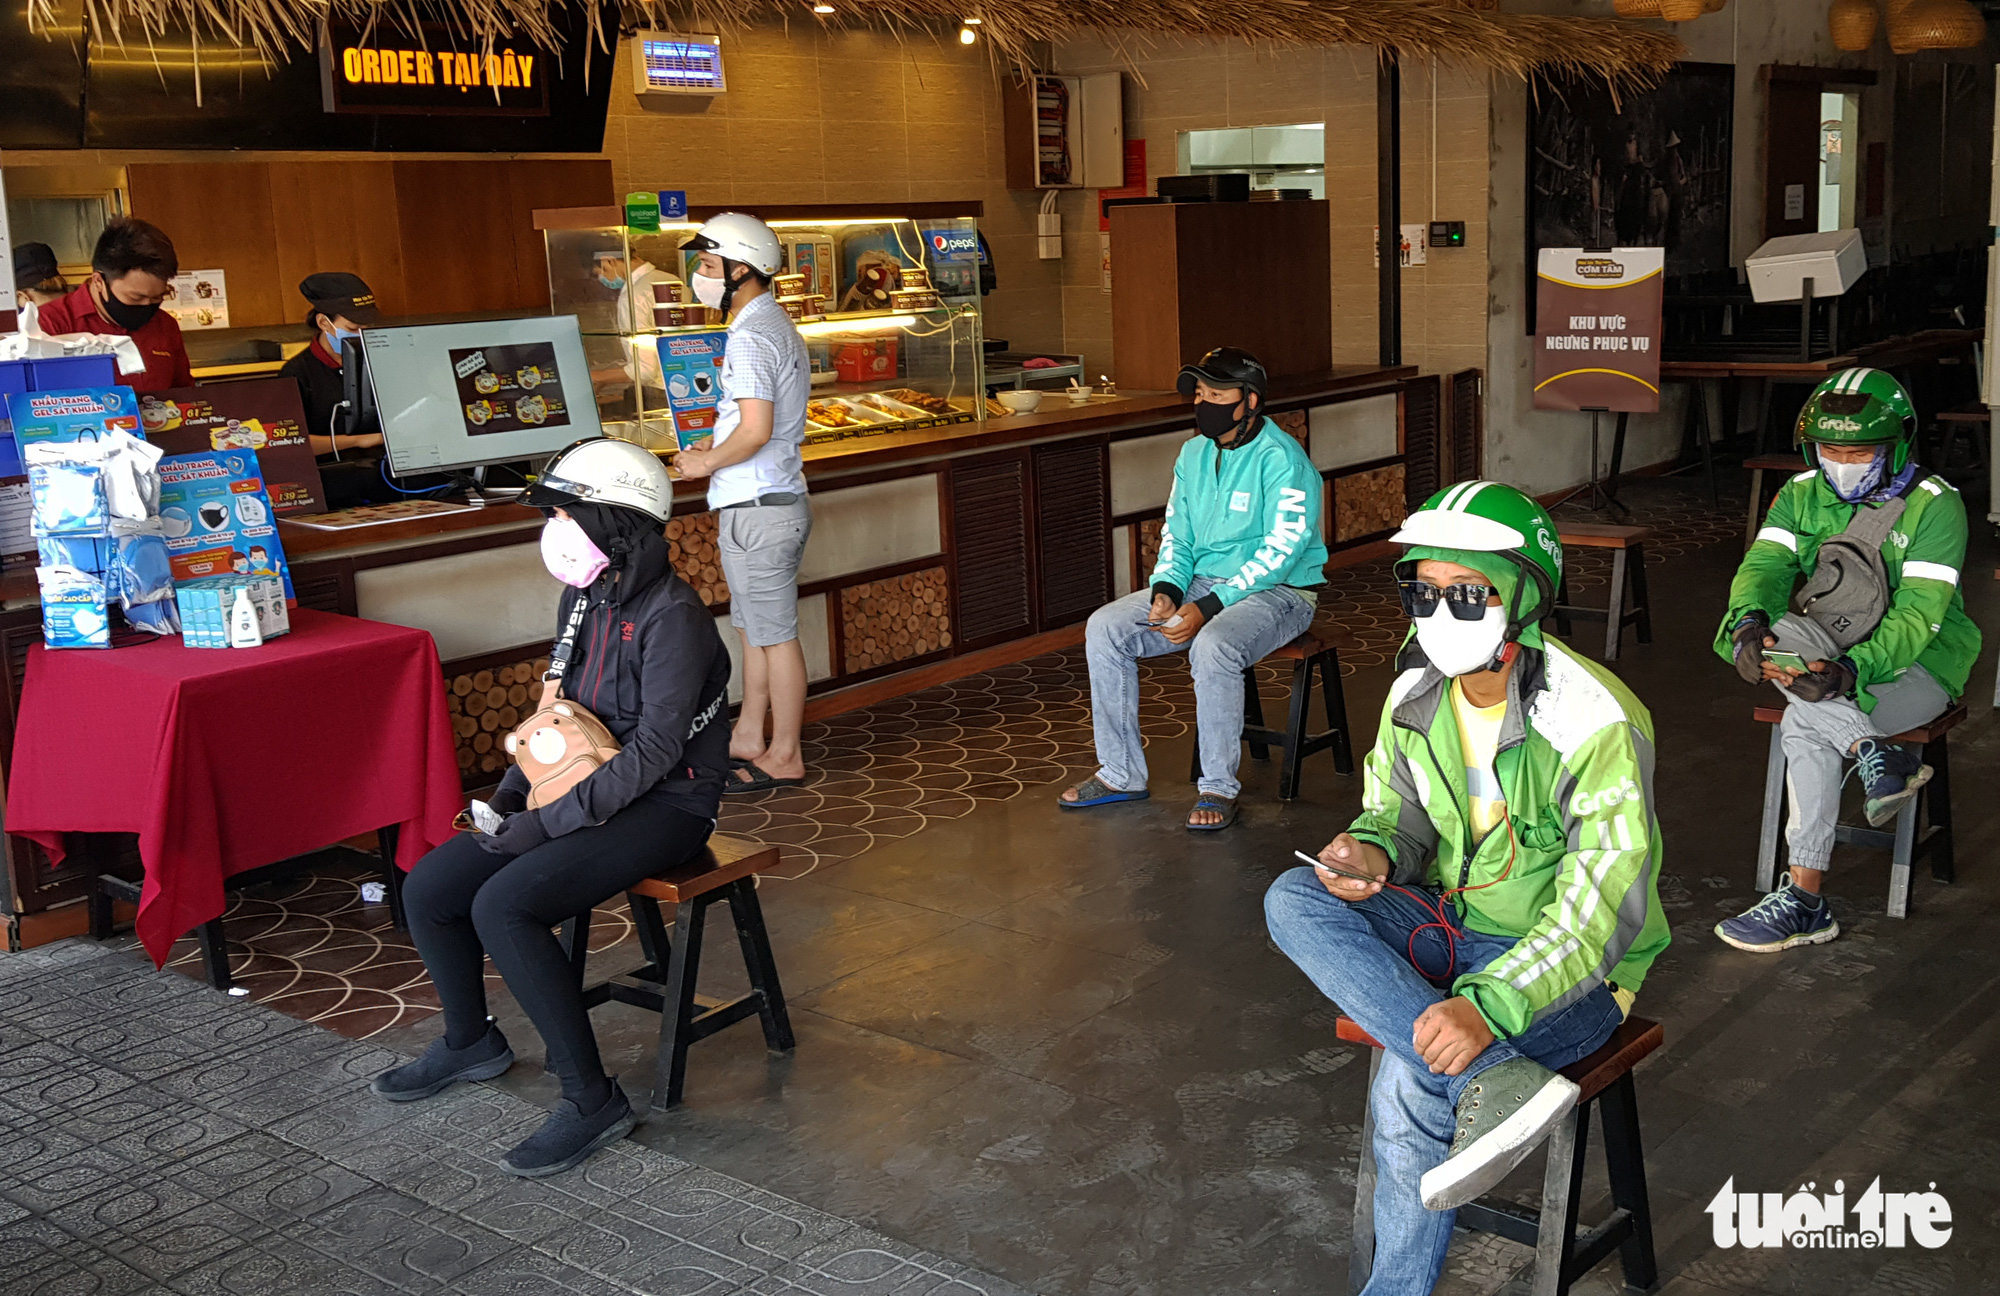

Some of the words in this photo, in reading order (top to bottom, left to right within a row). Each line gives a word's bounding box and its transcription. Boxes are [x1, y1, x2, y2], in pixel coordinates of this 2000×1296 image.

[343, 47, 435, 84] ORDER
[438, 52, 481, 93] TẠI
[485, 48, 534, 88] ĐÂY
[949, 237, 977, 251] peps
[1569, 316, 1596, 330] KHU
[1600, 314, 1627, 332] VỰC
[1593, 336, 1628, 353] PHỤC
[1631, 336, 1650, 353] VỤ
[60, 396, 91, 406] TRANG
[33, 408, 52, 418] GEL
[1818, 416, 1857, 432] Grab
[272, 427, 287, 438] 59
[268, 438, 293, 448] Combo
[186, 460, 215, 470] TRANG
[162, 474, 178, 483] GEL
[1226, 487, 1307, 591] BAEMIN
[1572, 775, 1640, 816] Grab
